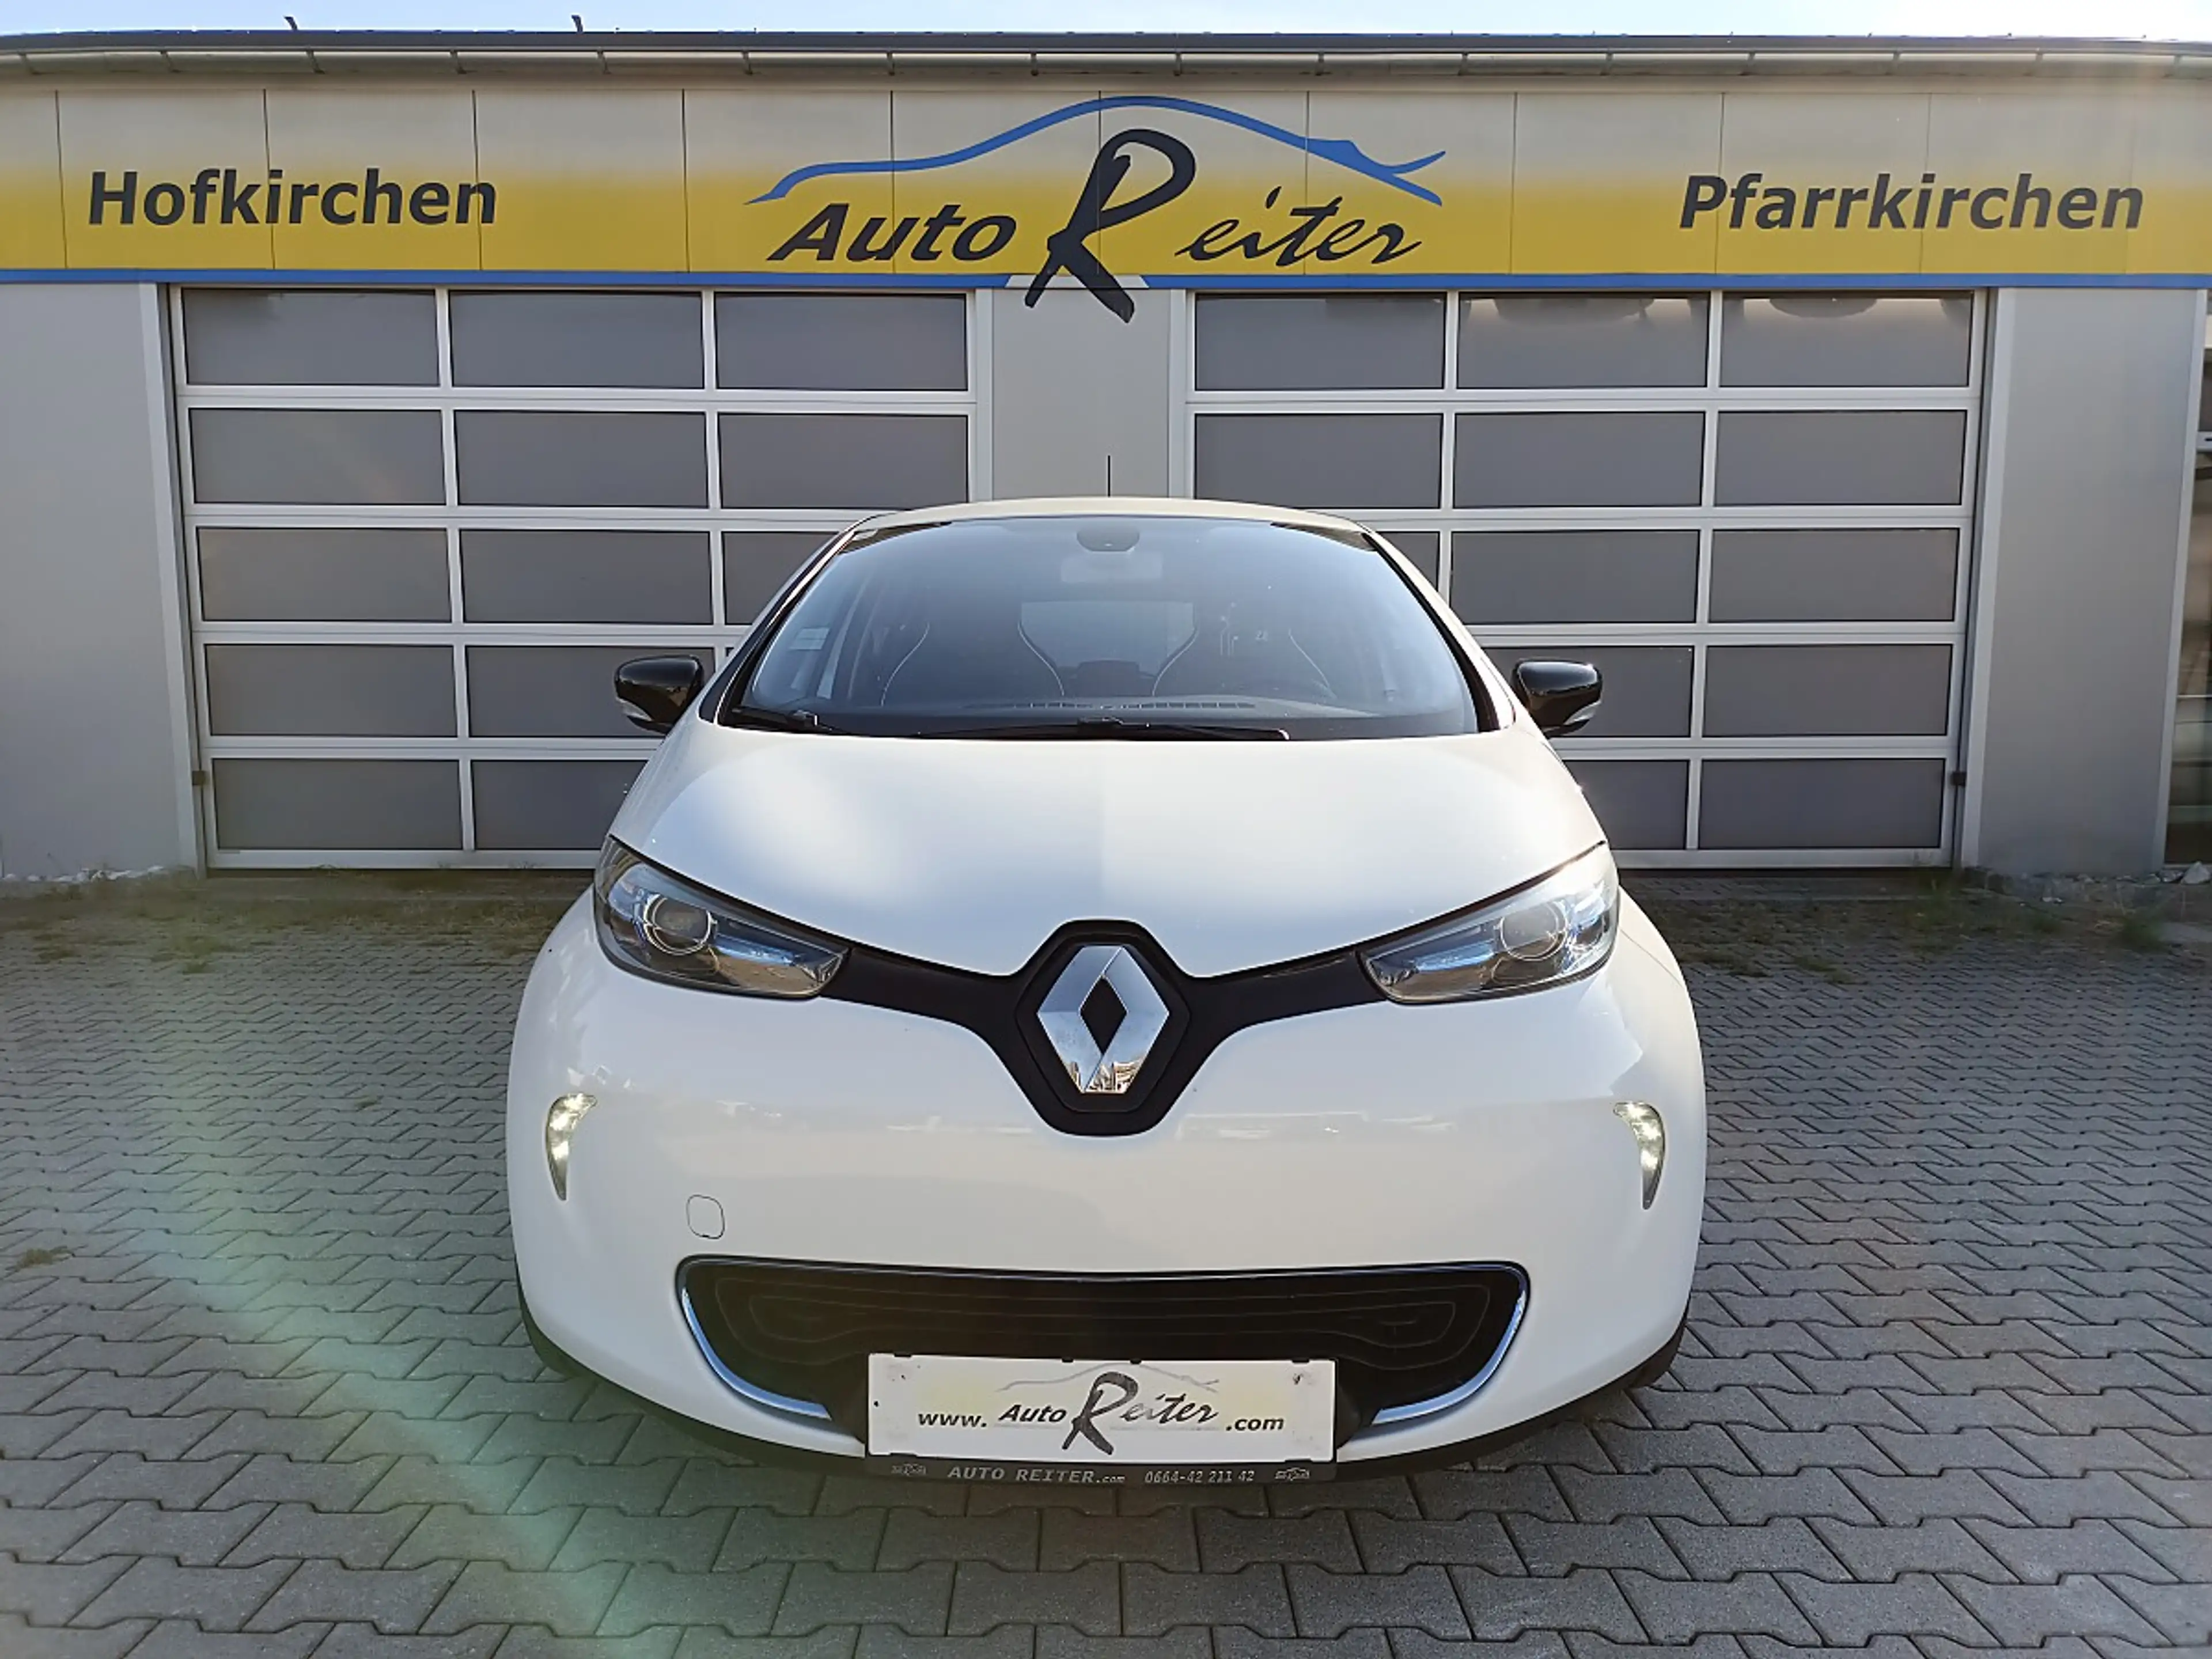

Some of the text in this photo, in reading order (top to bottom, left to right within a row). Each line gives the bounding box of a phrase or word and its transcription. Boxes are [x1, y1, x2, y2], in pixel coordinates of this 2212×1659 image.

[88, 167, 497, 226] Hofkirchen
[766, 128, 1422, 323] Auto Reiter
[1679, 172, 2143, 229] Pfarrkirchen
[918, 1371, 1285, 1456] www. Auto Reiter .com
[947, 1466, 1005, 1480] AUTO
